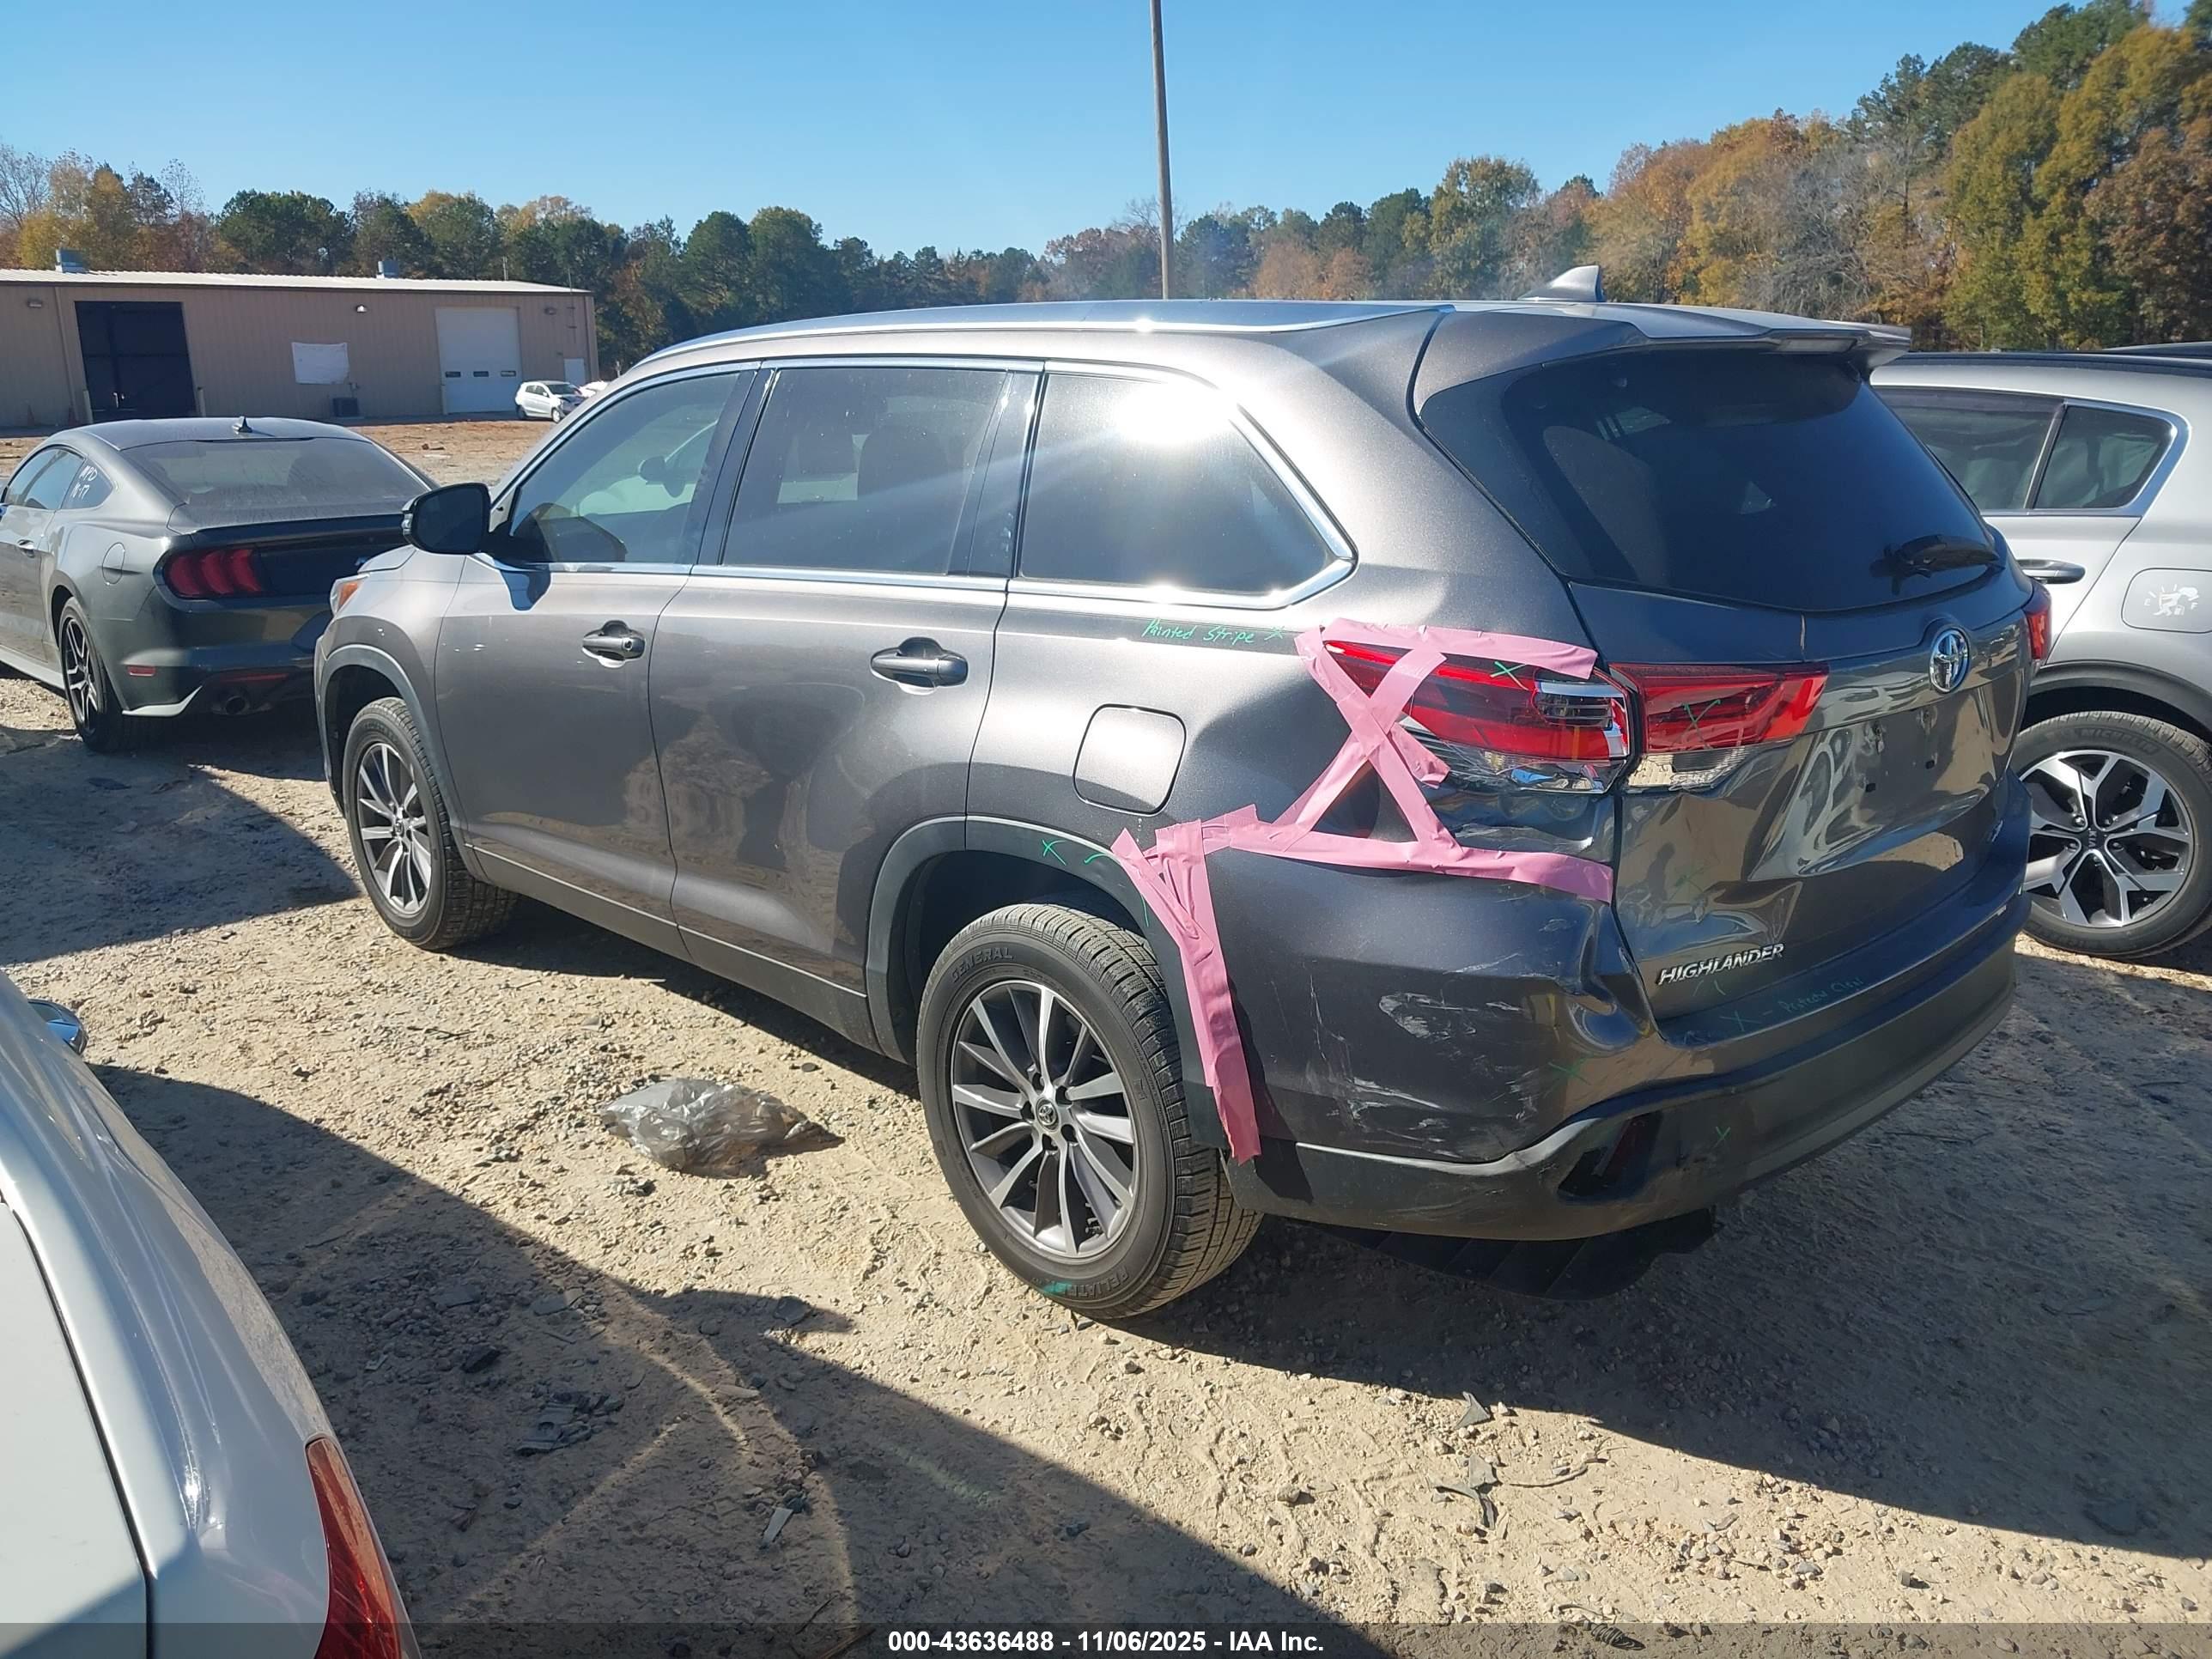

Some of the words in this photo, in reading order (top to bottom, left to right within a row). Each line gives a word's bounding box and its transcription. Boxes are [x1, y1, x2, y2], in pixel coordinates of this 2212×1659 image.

[1141, 618, 1198, 641] Painted
[951, 947, 1015, 984] GENERAL
[1656, 944, 1785, 987] HIGHLANDER
